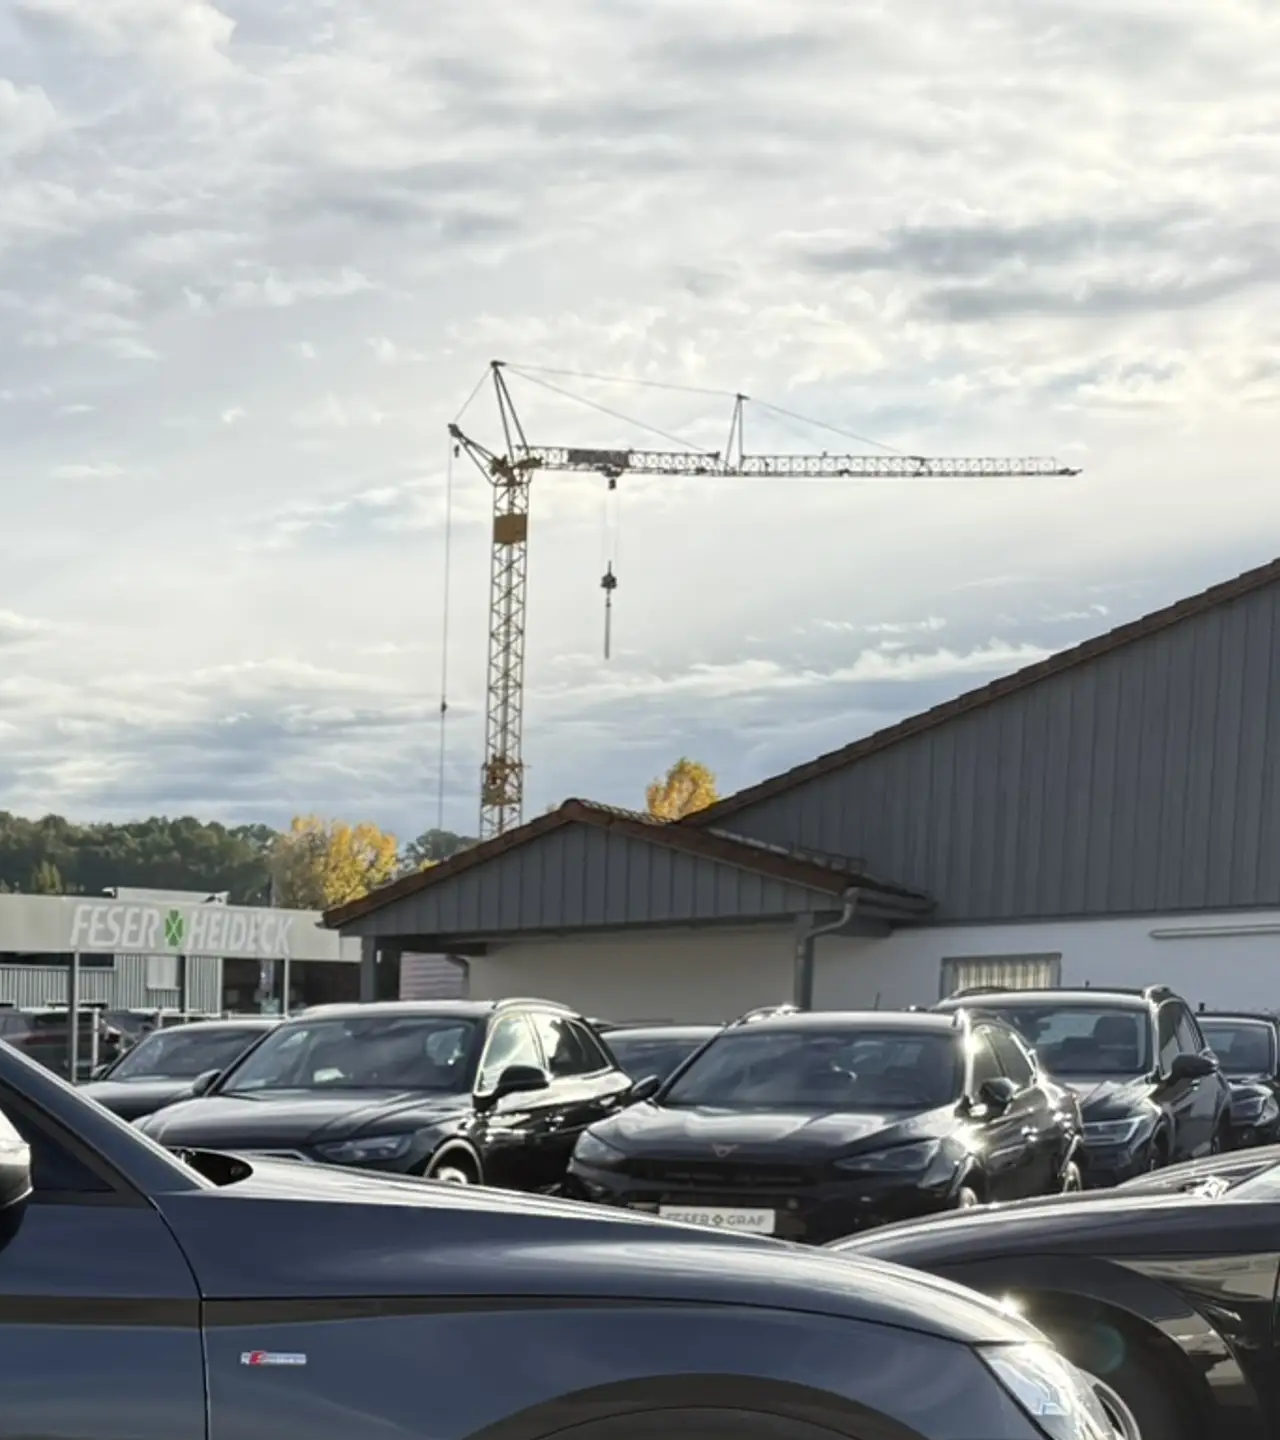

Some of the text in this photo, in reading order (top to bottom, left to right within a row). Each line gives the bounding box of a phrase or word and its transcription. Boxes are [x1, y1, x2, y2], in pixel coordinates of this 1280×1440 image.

[69, 904, 293, 953] FESER HEIDECK
[726, 1214, 766, 1226] GRAF
